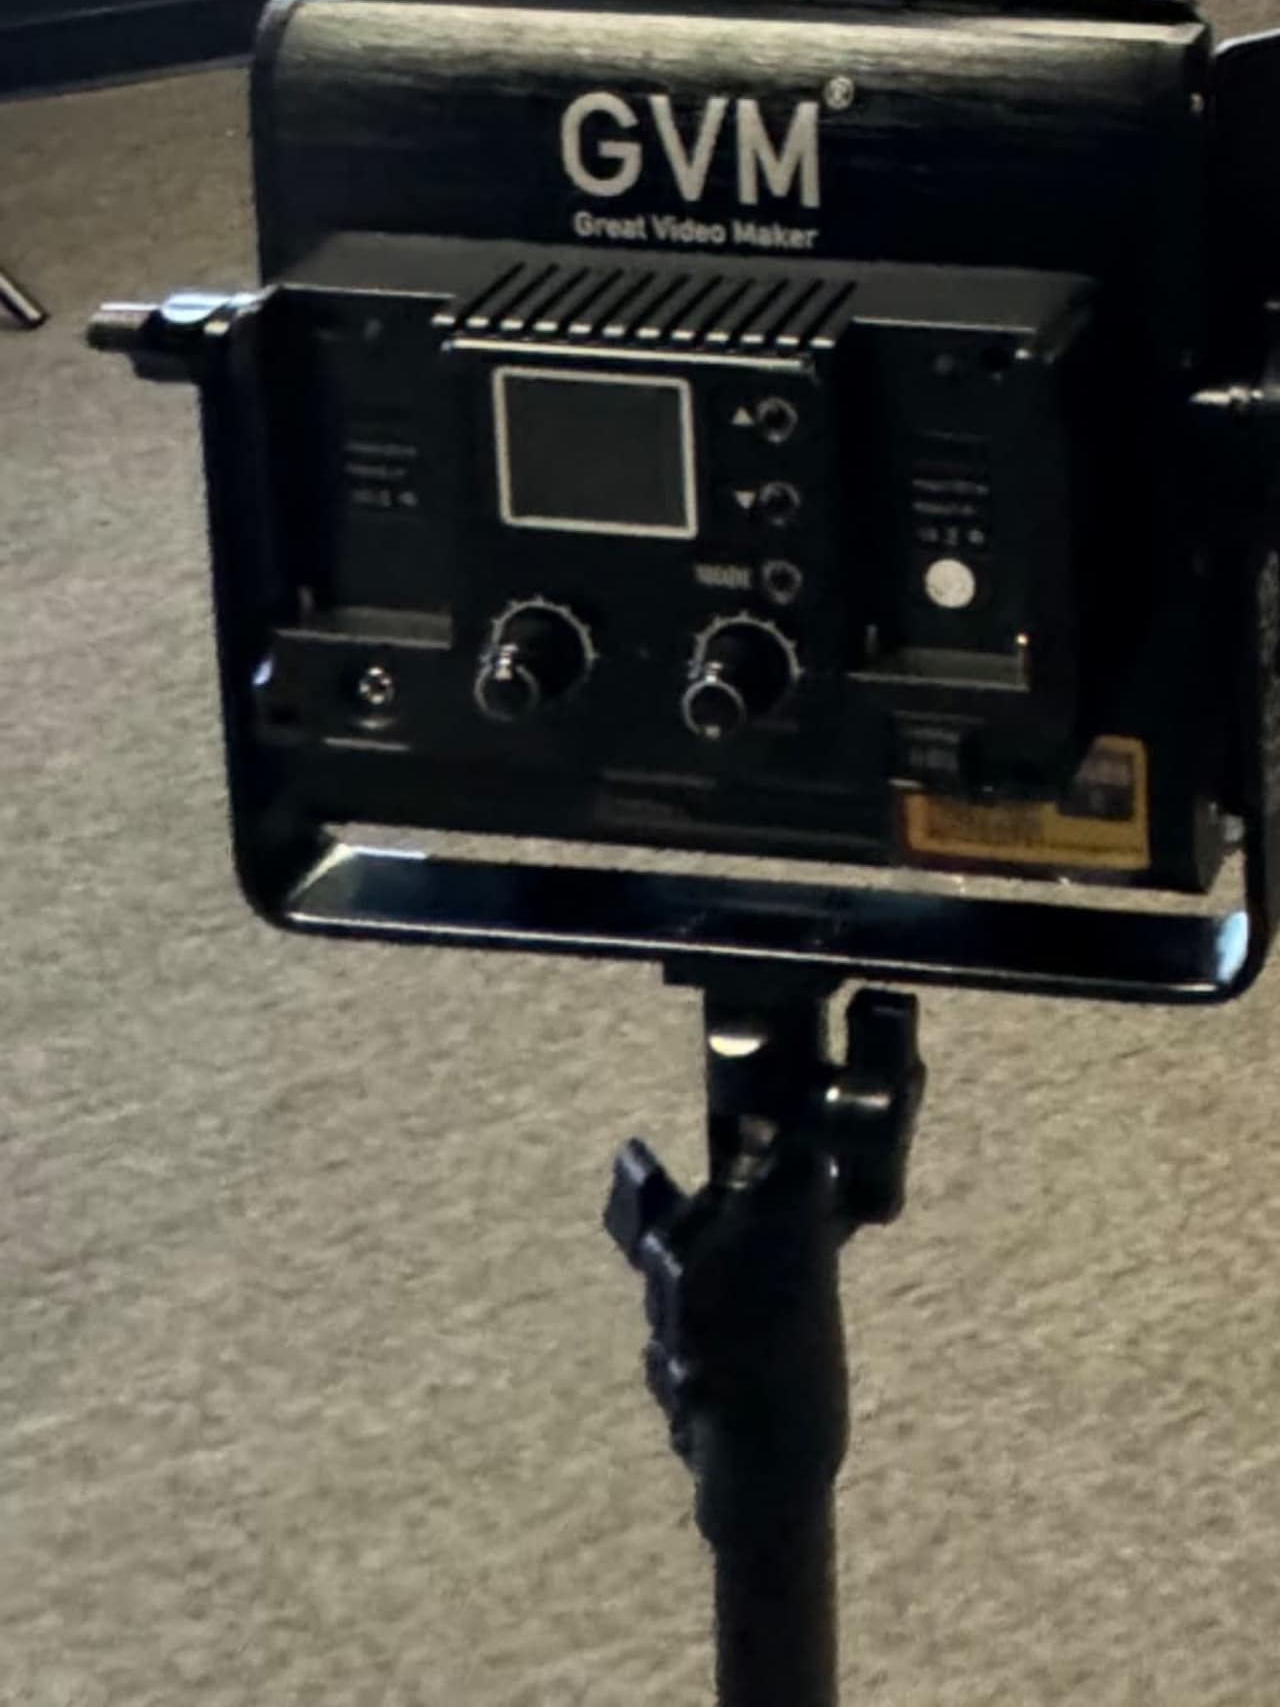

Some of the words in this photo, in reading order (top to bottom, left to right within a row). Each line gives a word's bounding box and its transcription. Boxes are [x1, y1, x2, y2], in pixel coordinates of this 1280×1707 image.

[573, 211, 648, 241] Great
[651, 214, 727, 244] Video
[731, 220, 819, 250] Maker
